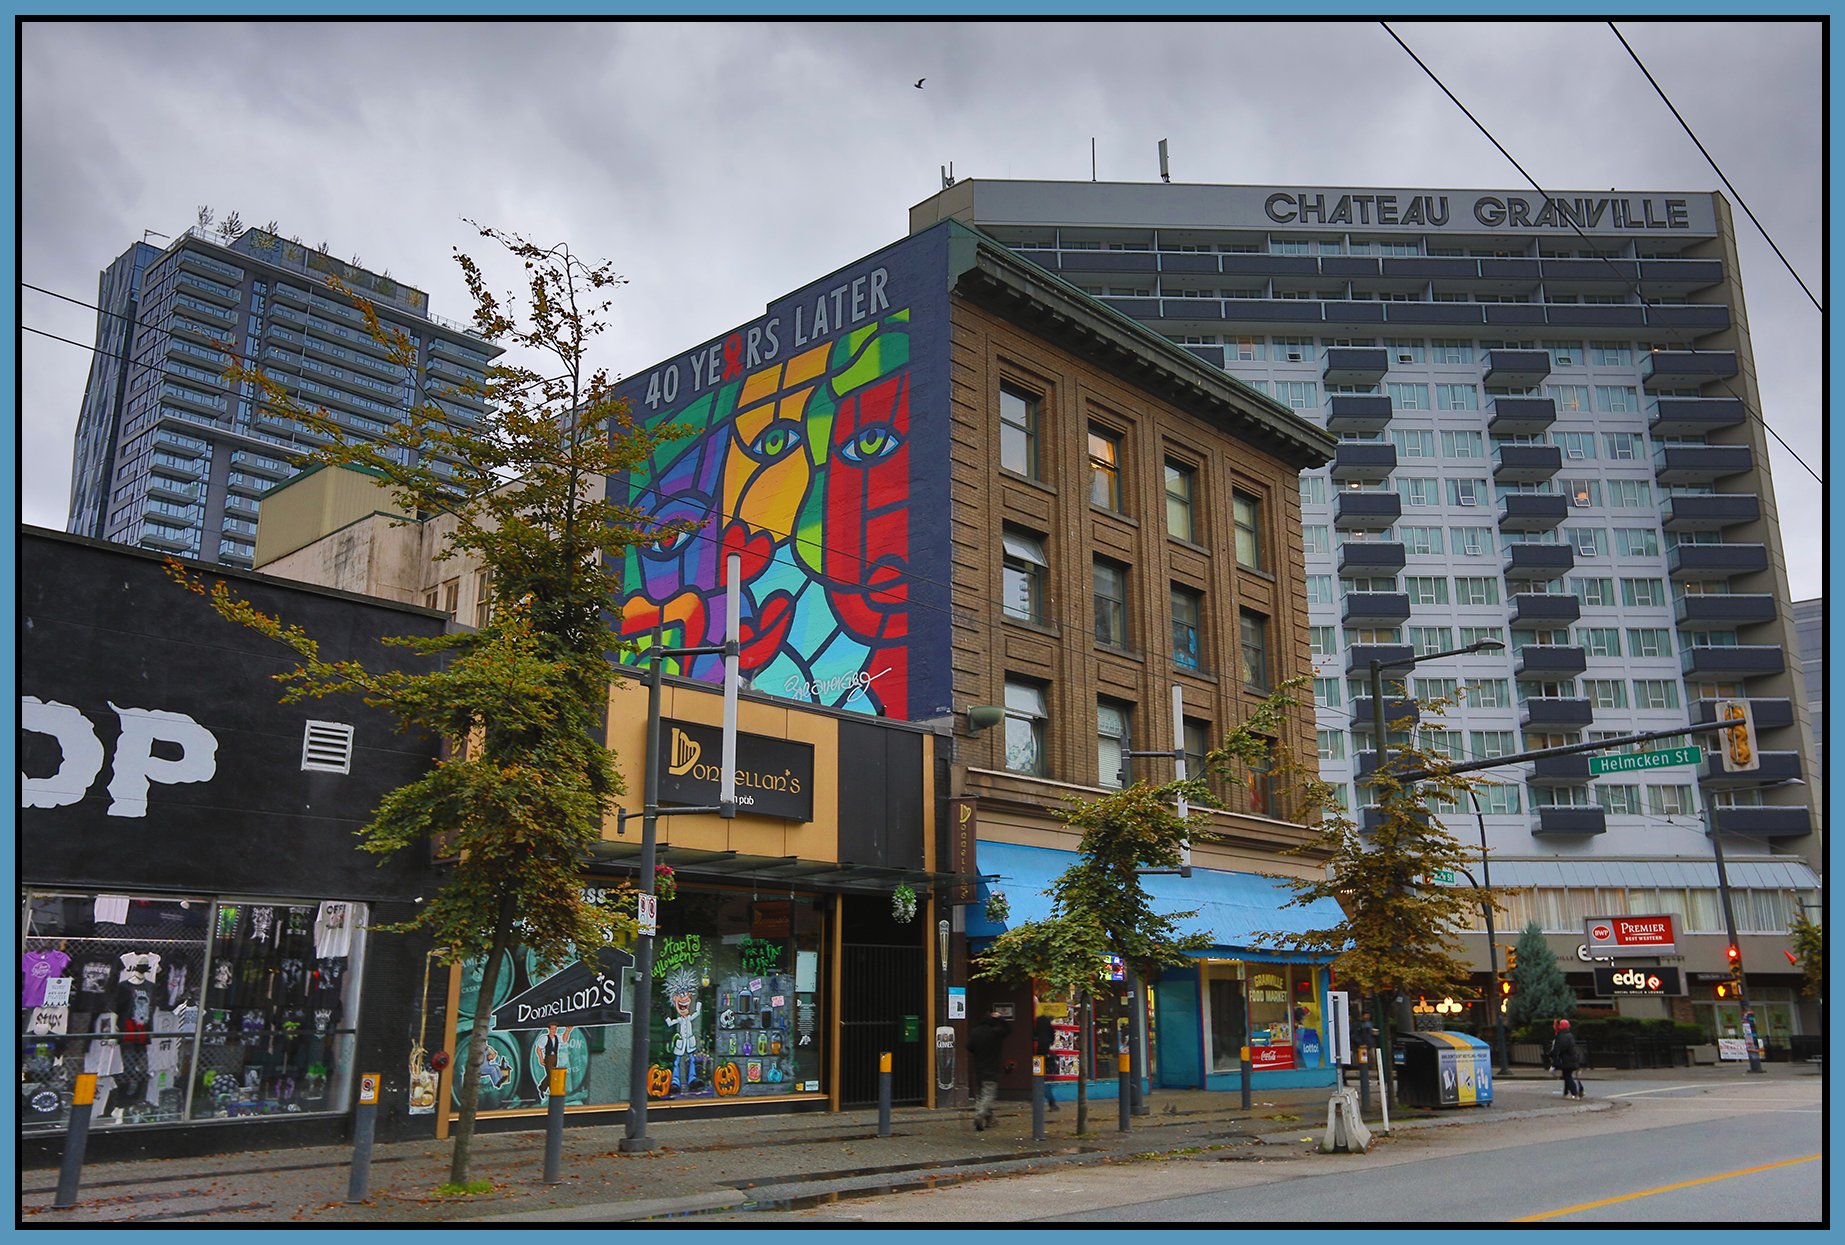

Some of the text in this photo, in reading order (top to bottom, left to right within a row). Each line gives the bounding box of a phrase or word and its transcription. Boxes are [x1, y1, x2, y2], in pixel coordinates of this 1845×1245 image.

[1265, 192, 1690, 230] CHATEAU GRANVILLE
[645, 365, 679, 410] 40
[795, 267, 889, 347] LATER
[669, 727, 801, 794] Donellan's
[1600, 748, 1690, 772] Helmcken St
[739, 794, 754, 805] pub
[1594, 929, 1609, 937] BWP
[659, 934, 701, 958] Happy
[651, 952, 695, 979] alloween
[1253, 973, 1284, 990] GRANVILLE
[1248, 990, 1288, 1002] FOOD MARKET
